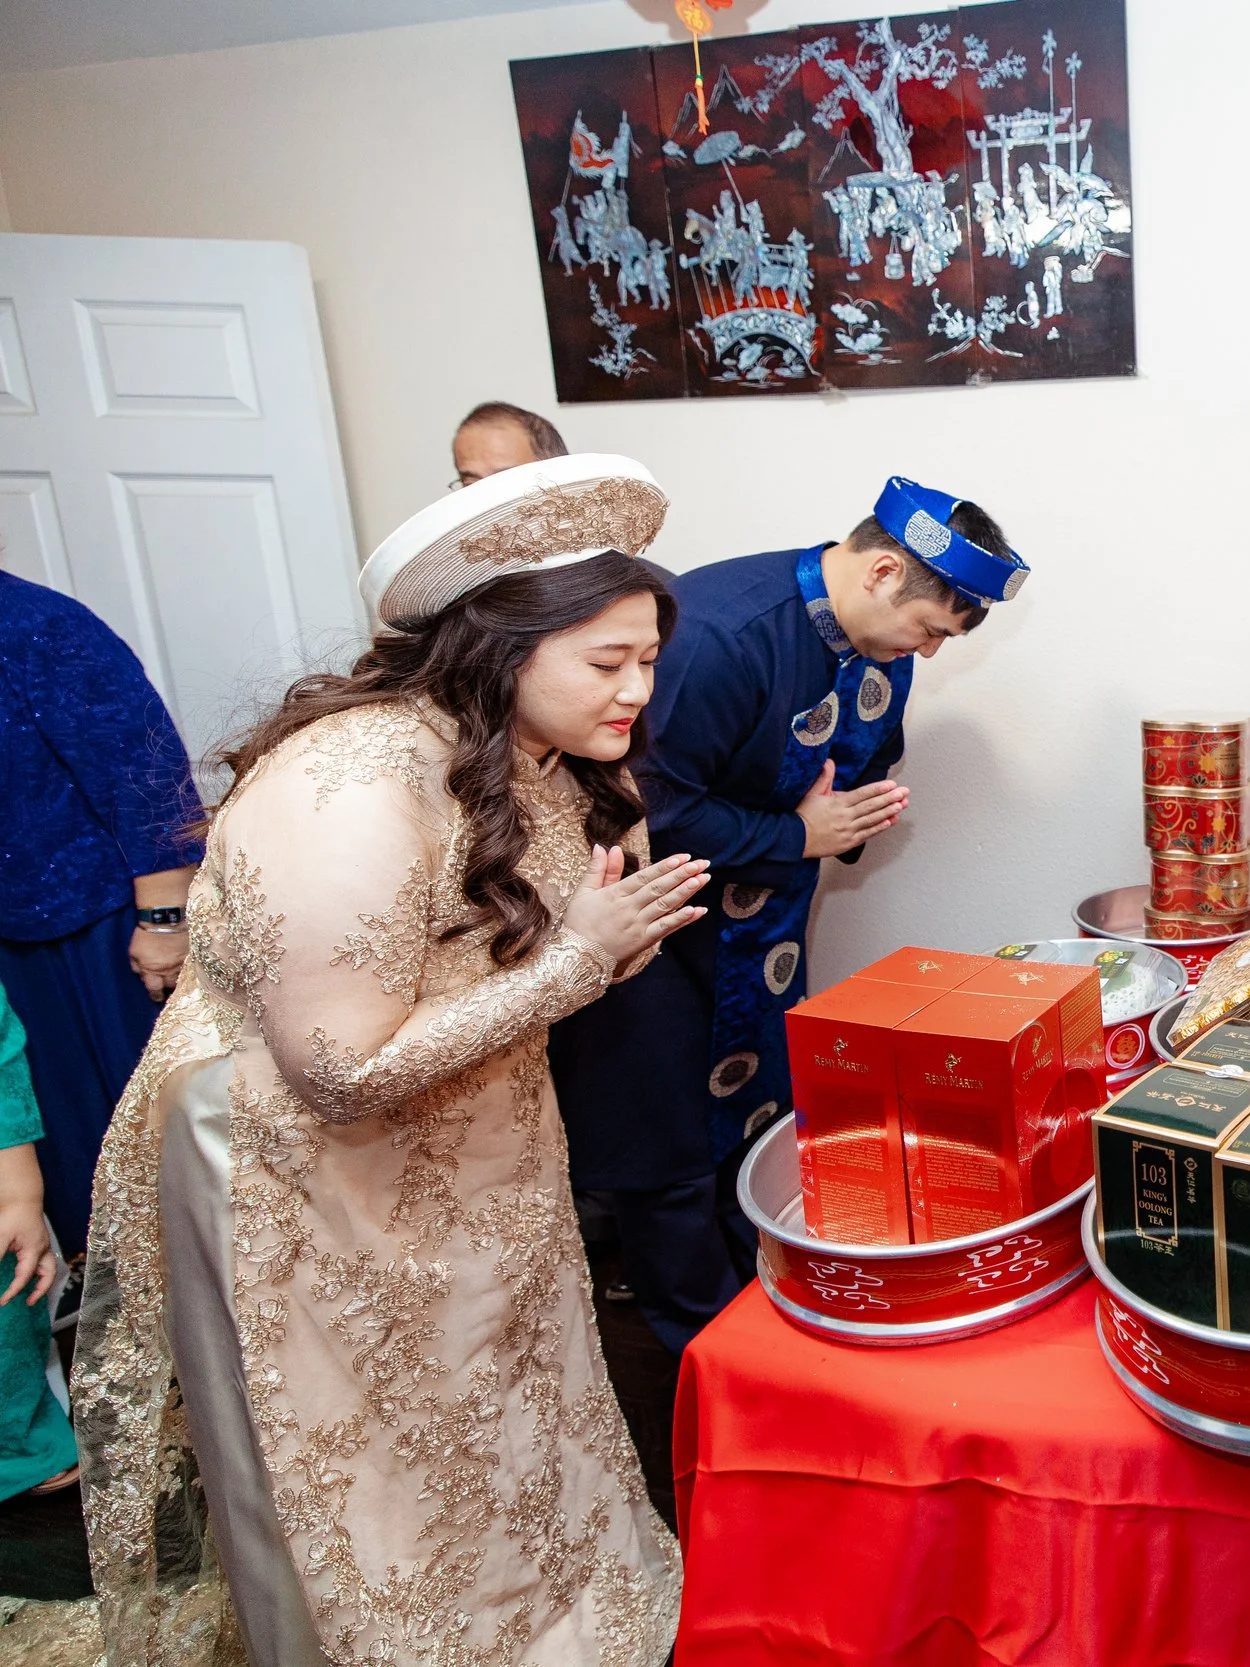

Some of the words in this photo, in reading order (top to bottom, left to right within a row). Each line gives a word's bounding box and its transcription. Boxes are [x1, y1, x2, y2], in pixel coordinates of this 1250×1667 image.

[1141, 1163, 1167, 1186] 103
[1143, 1188, 1168, 1202] KING's
[1138, 1200, 1172, 1216] OOLONG
[1148, 1214, 1164, 1226] TEA
